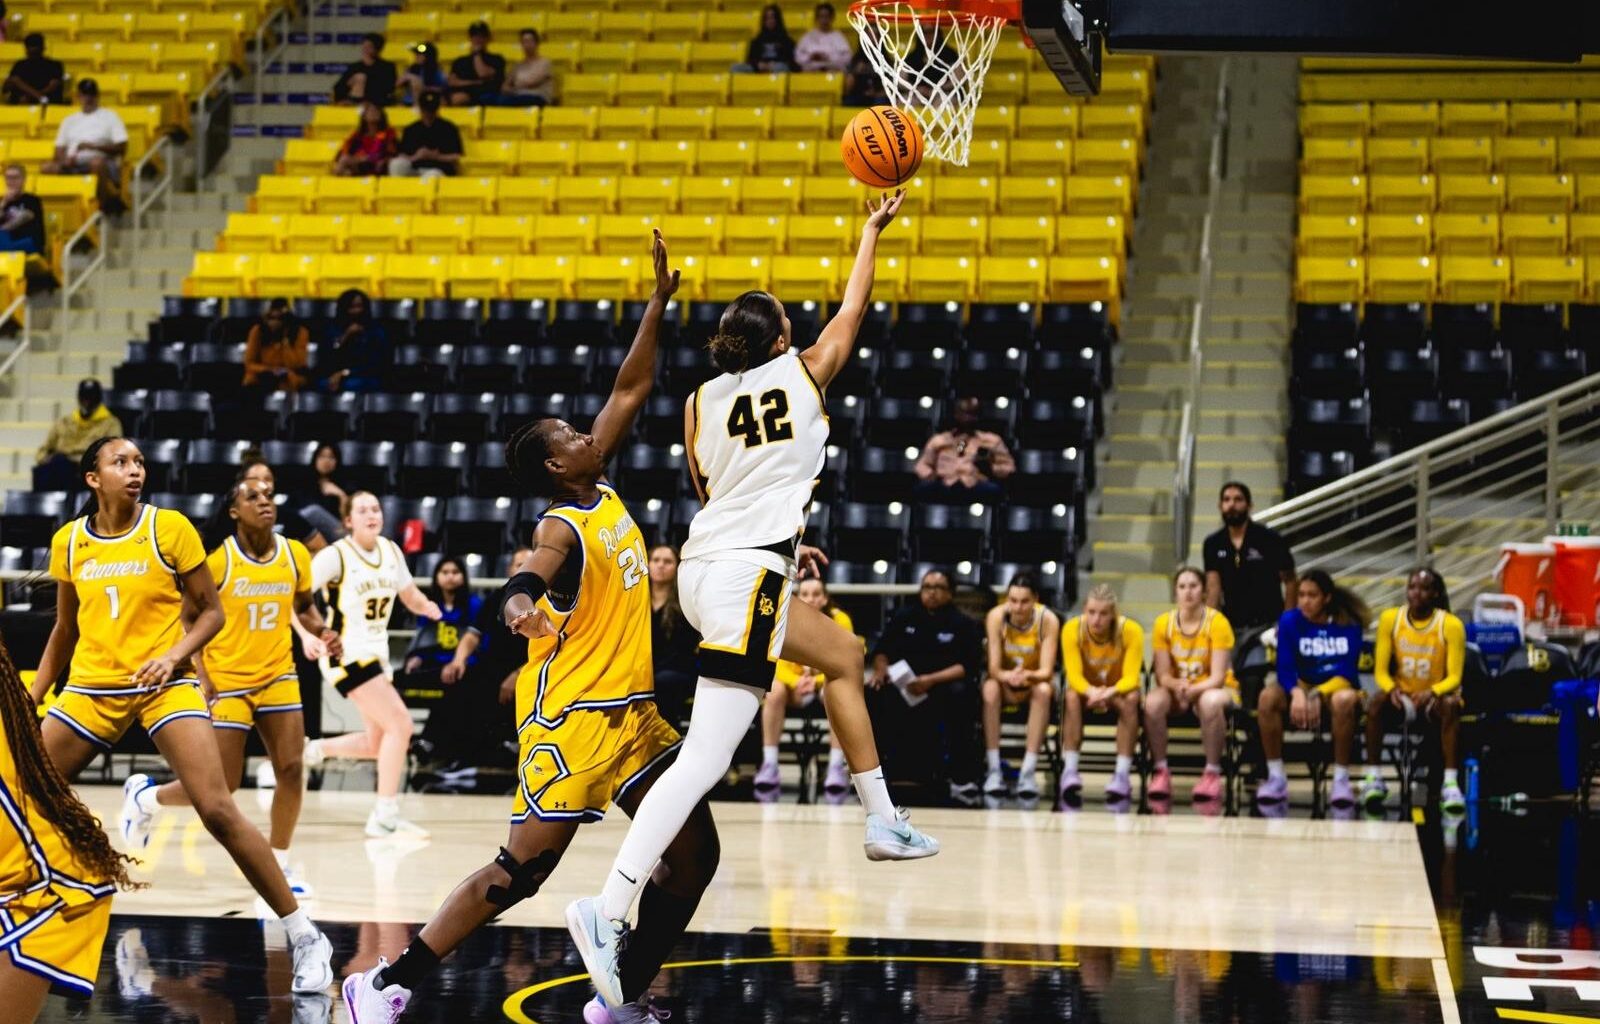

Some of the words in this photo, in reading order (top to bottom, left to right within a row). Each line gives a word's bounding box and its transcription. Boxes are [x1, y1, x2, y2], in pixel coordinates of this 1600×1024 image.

[861, 125, 883, 155] EVO
[882, 109, 908, 158] Wilson
[727, 388, 794, 449] 42
[79, 557, 150, 582] Runners
[617, 537, 648, 591] 24
[104, 585, 120, 619] 1
[231, 577, 292, 597] Runners
[247, 601, 280, 631] 12
[1299, 636, 1349, 656] CSUB
